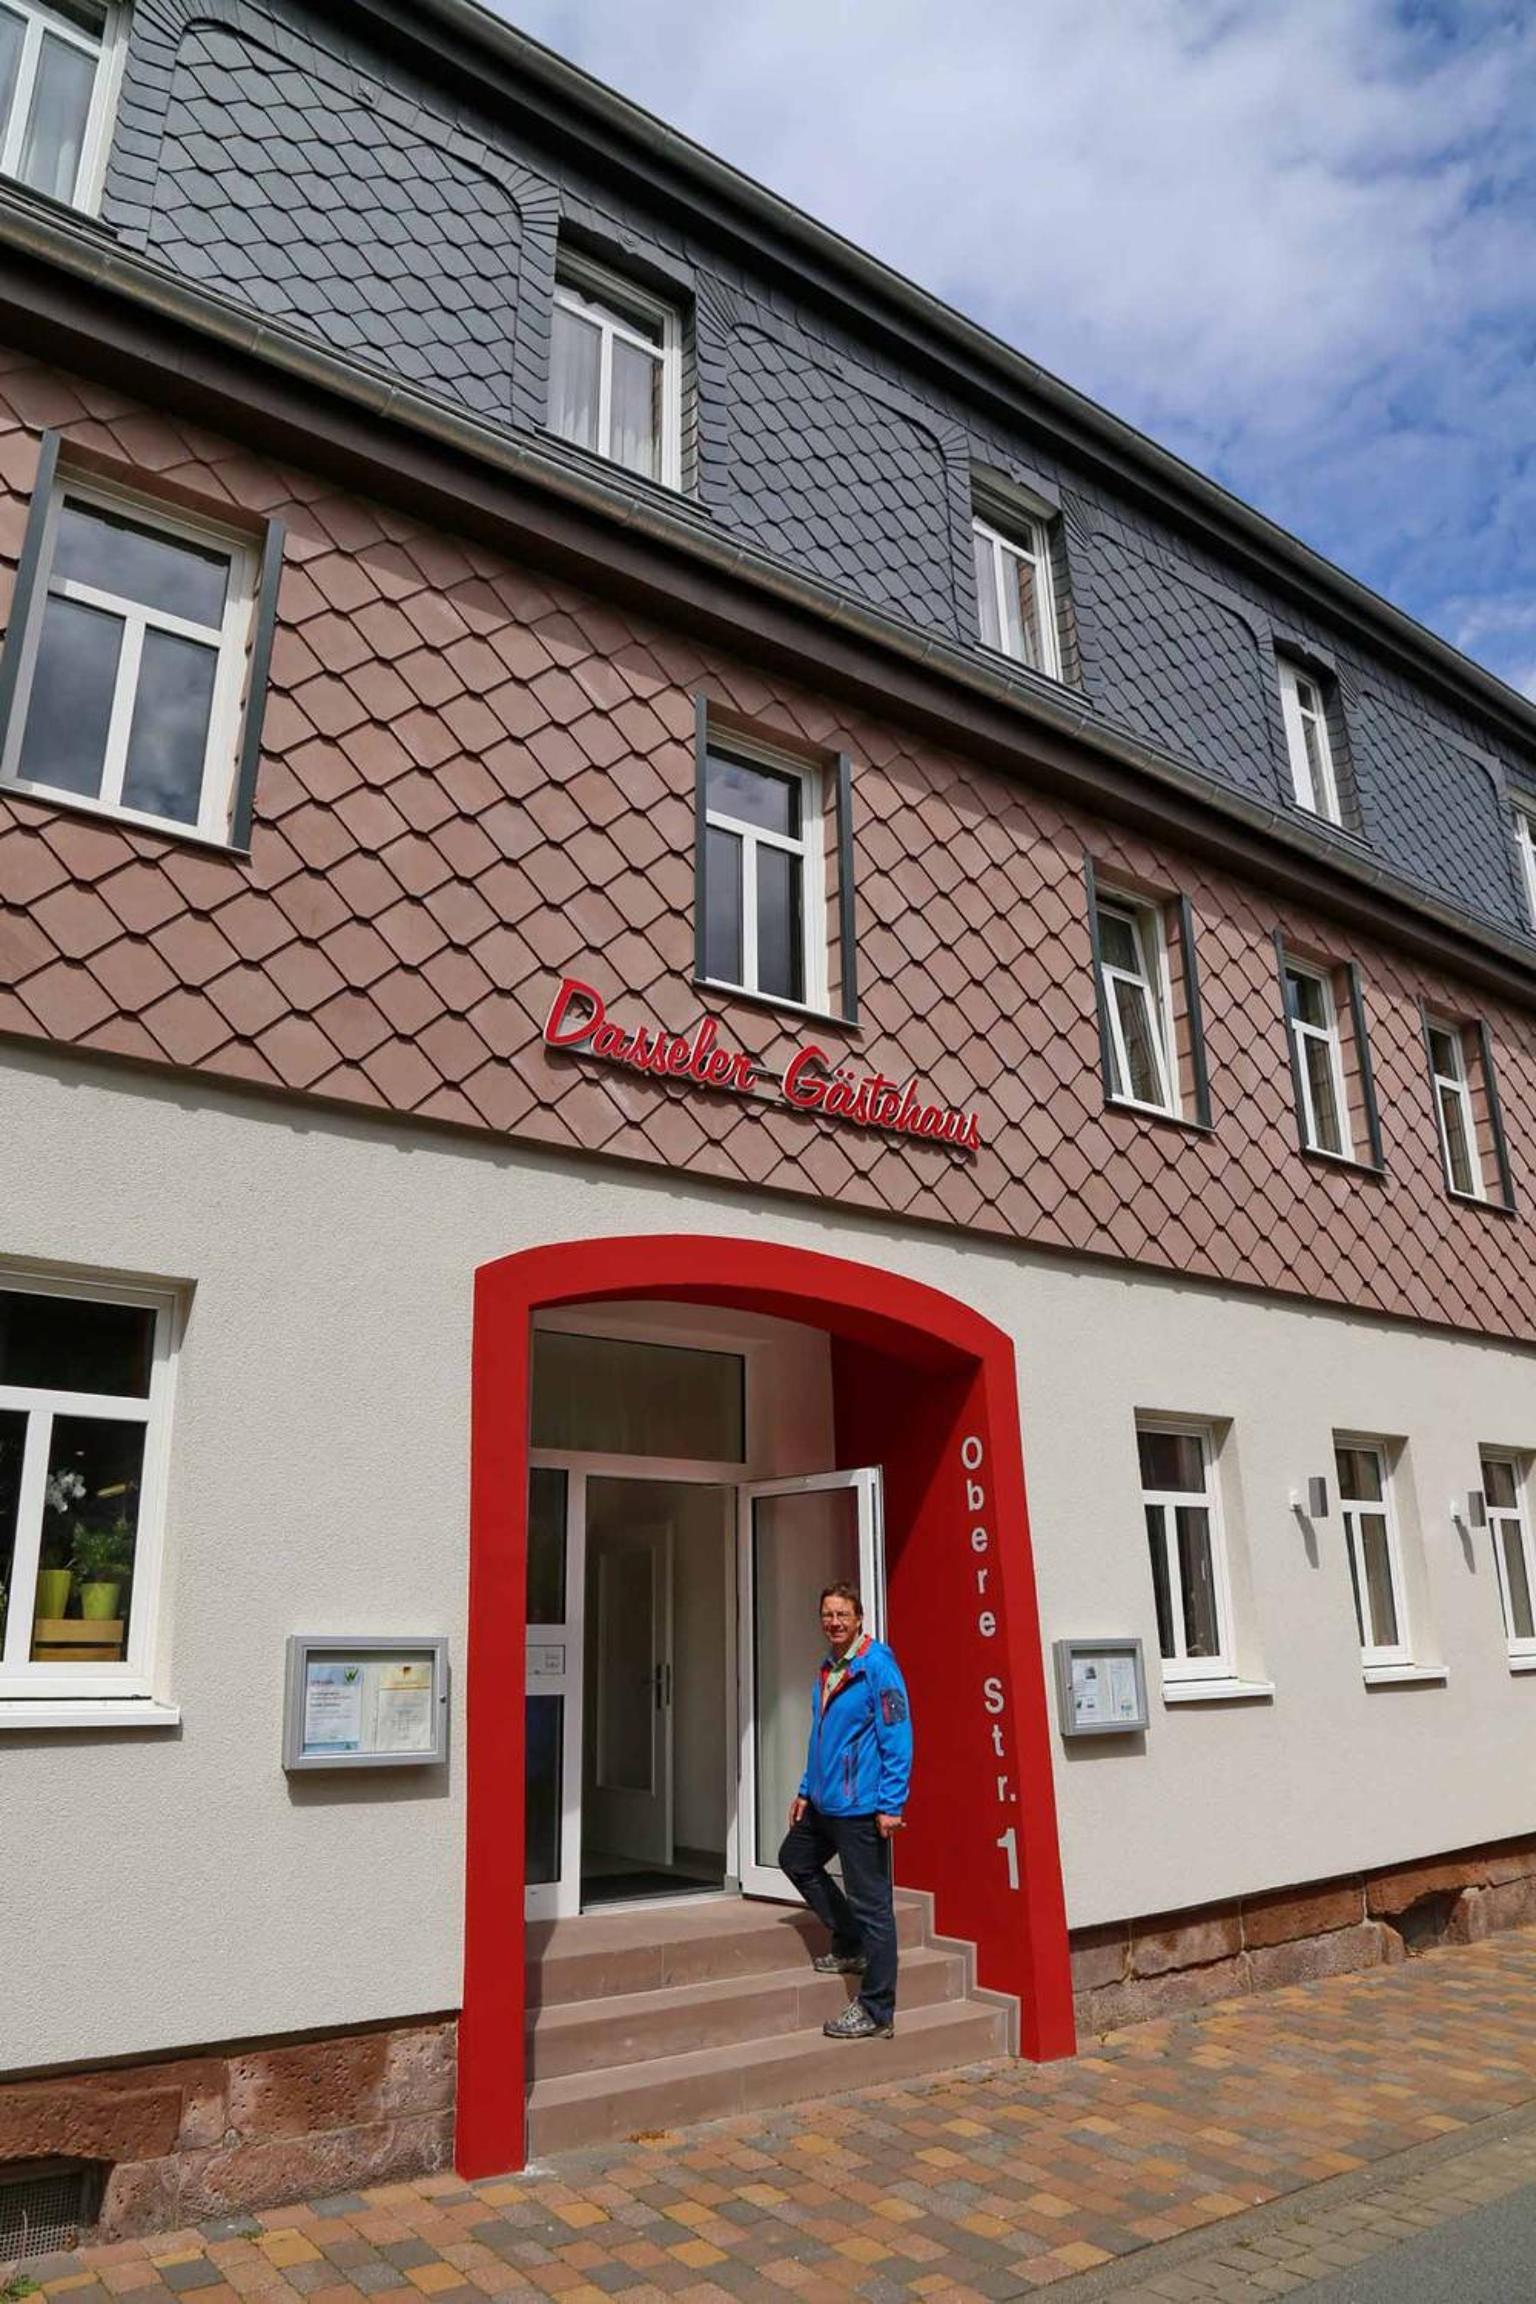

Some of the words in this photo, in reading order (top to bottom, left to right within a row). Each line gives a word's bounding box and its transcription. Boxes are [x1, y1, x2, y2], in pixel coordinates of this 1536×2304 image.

[544, 977, 757, 1091] Dasseler
[781, 1045, 981, 1150] Gästehaus
[961, 1436, 997, 1637] Obere
[984, 1677, 1017, 1802] Str.
[997, 1828, 1020, 1890] 1
